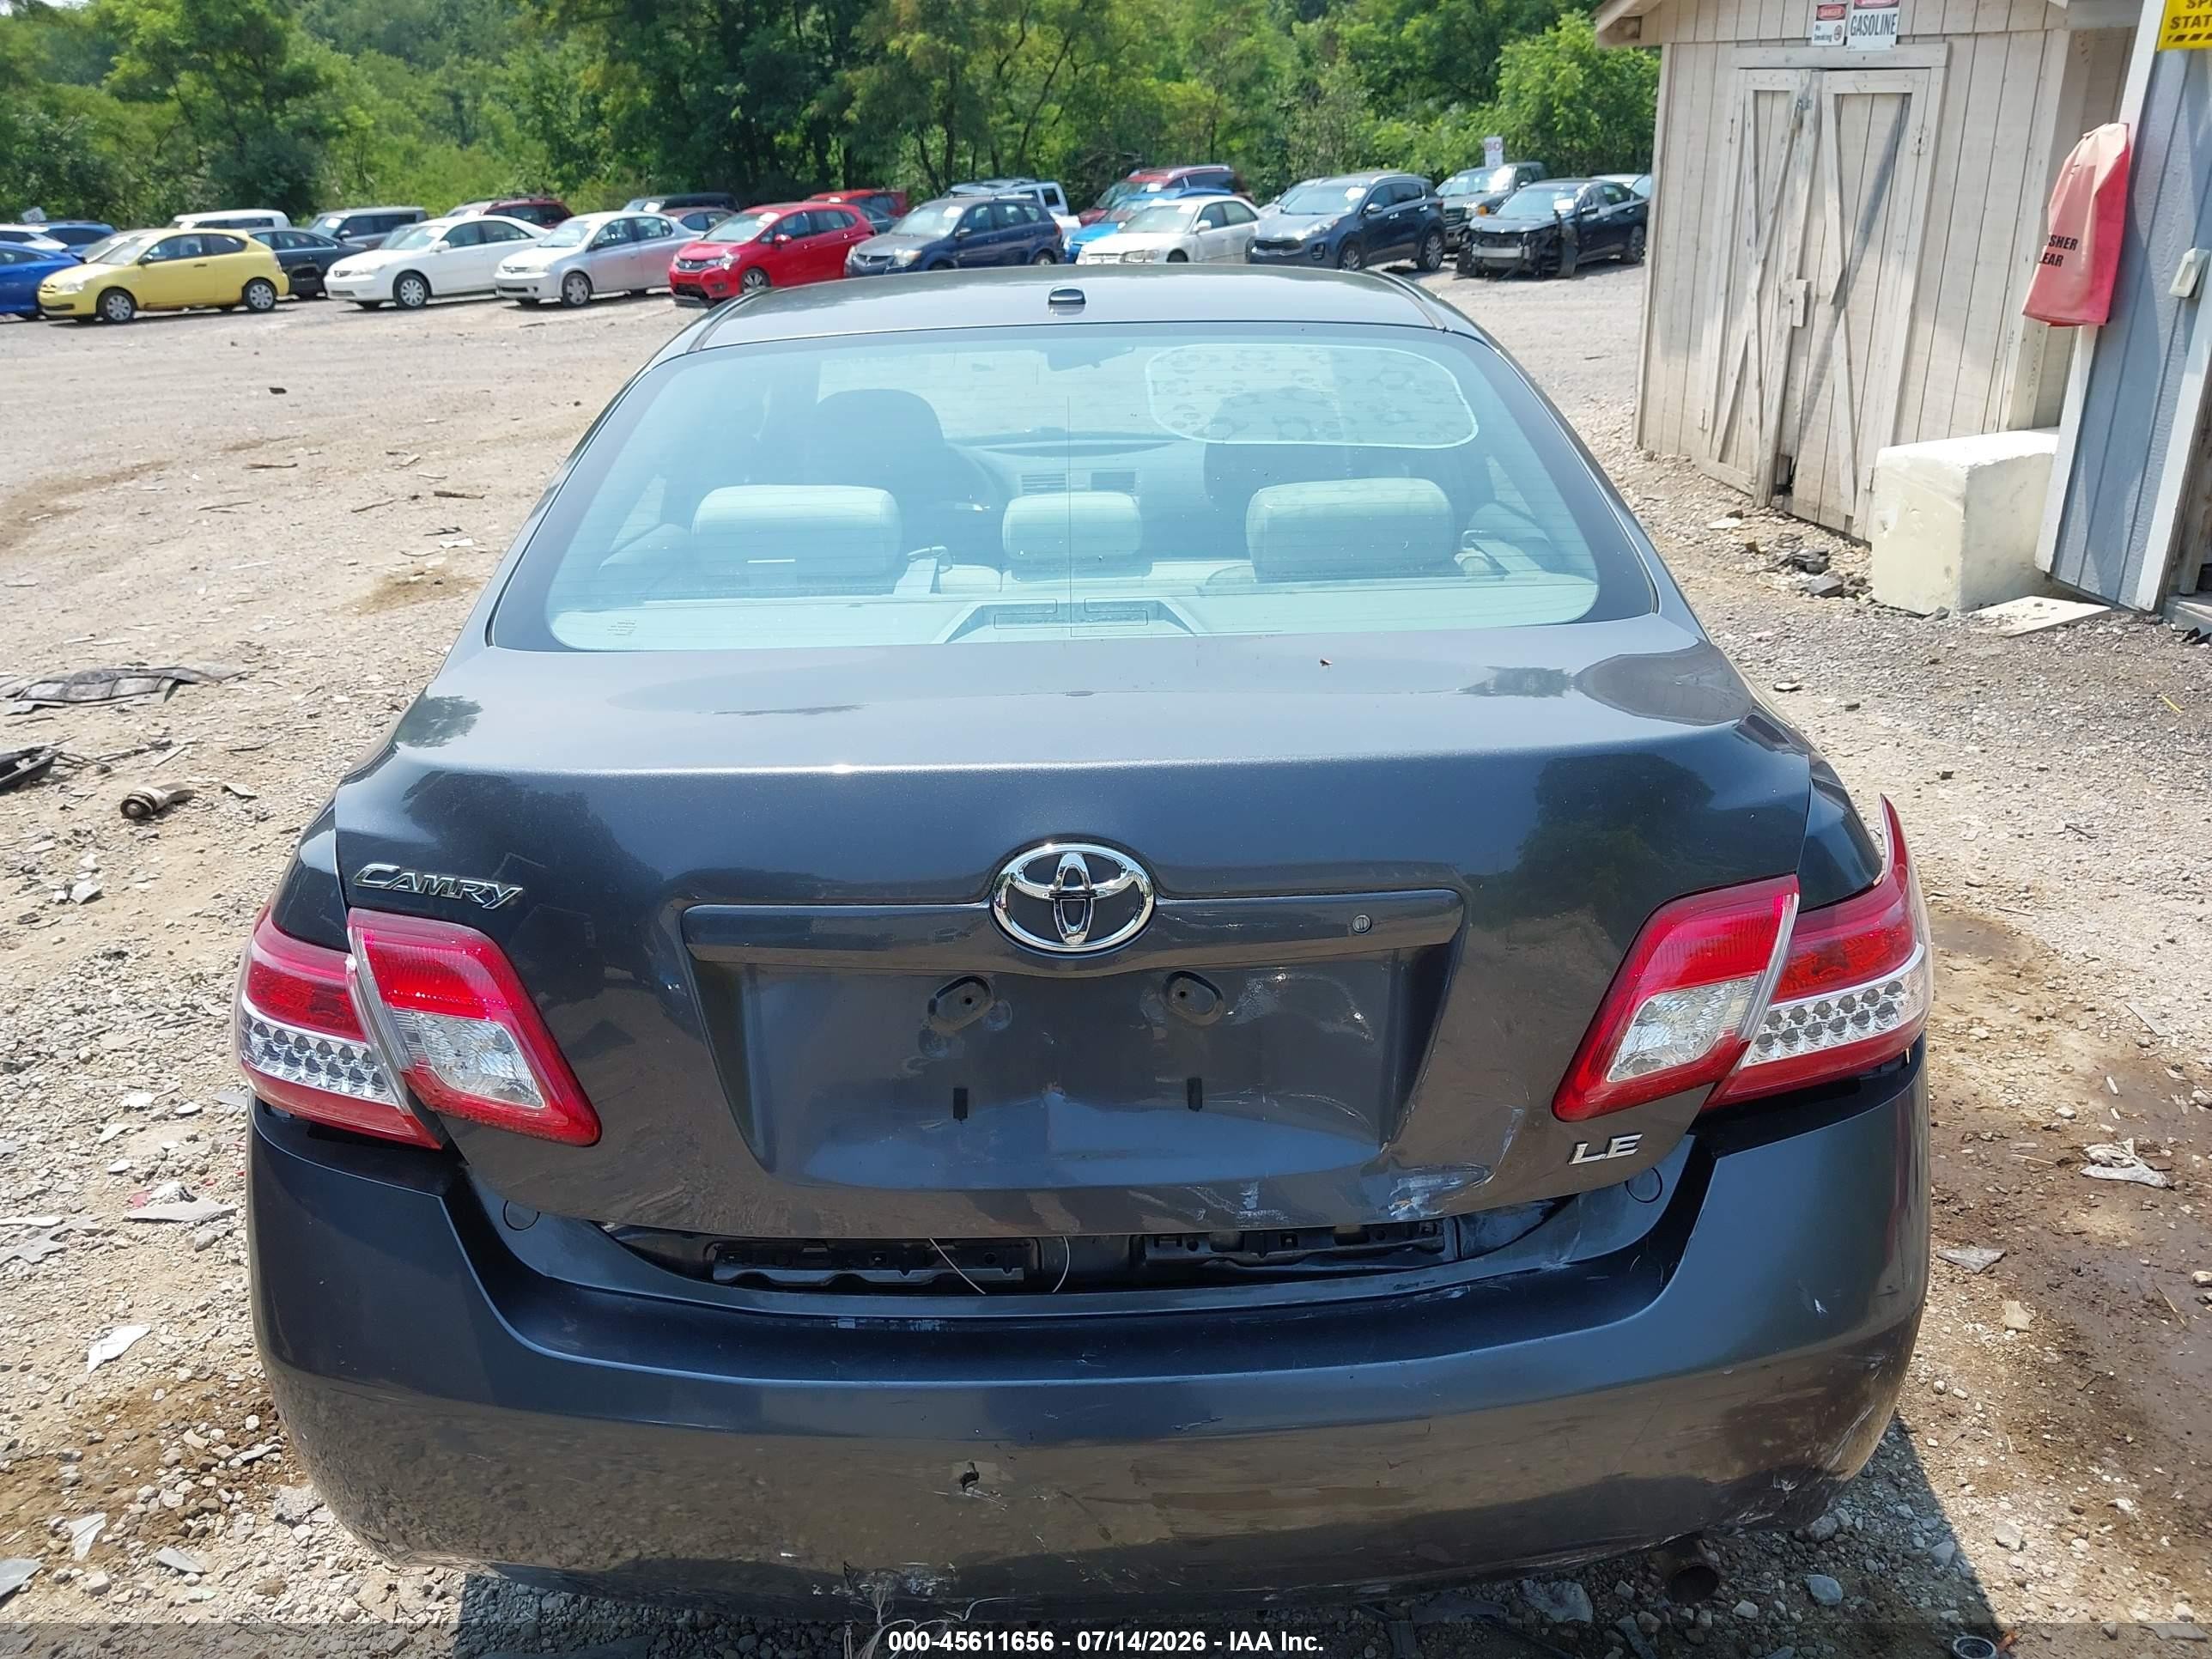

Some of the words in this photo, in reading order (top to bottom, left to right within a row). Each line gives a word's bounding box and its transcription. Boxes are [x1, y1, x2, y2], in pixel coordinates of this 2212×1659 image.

[1850, 13, 1898, 36] GASOLINE
[2048, 234, 2079, 251] SHER
[352, 863, 524, 909] CAMRY
[1568, 1132, 1644, 1164] LE
